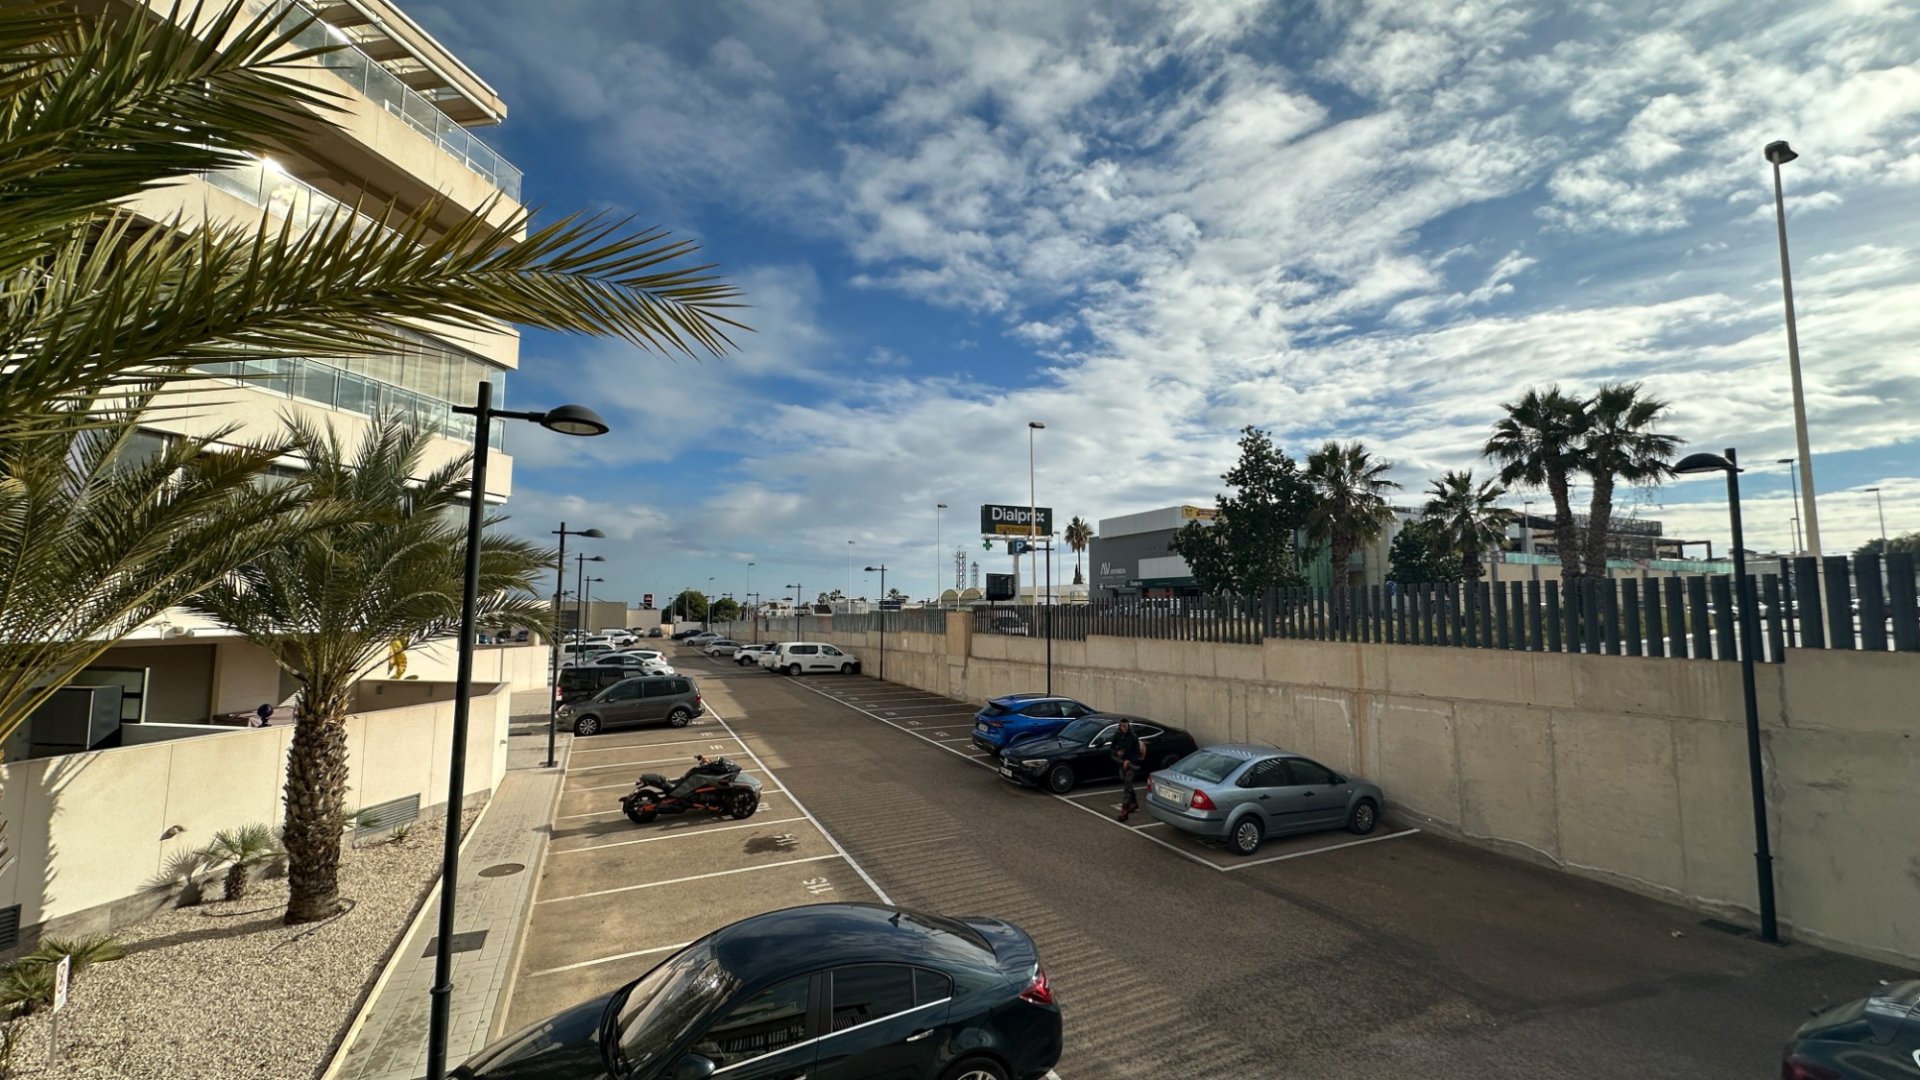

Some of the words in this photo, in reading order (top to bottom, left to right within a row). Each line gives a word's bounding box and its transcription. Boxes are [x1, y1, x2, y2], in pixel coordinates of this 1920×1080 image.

[991, 507, 1045, 524] Dialprx
[1016, 541, 1024, 552] P
[802, 877, 834, 895] 115
